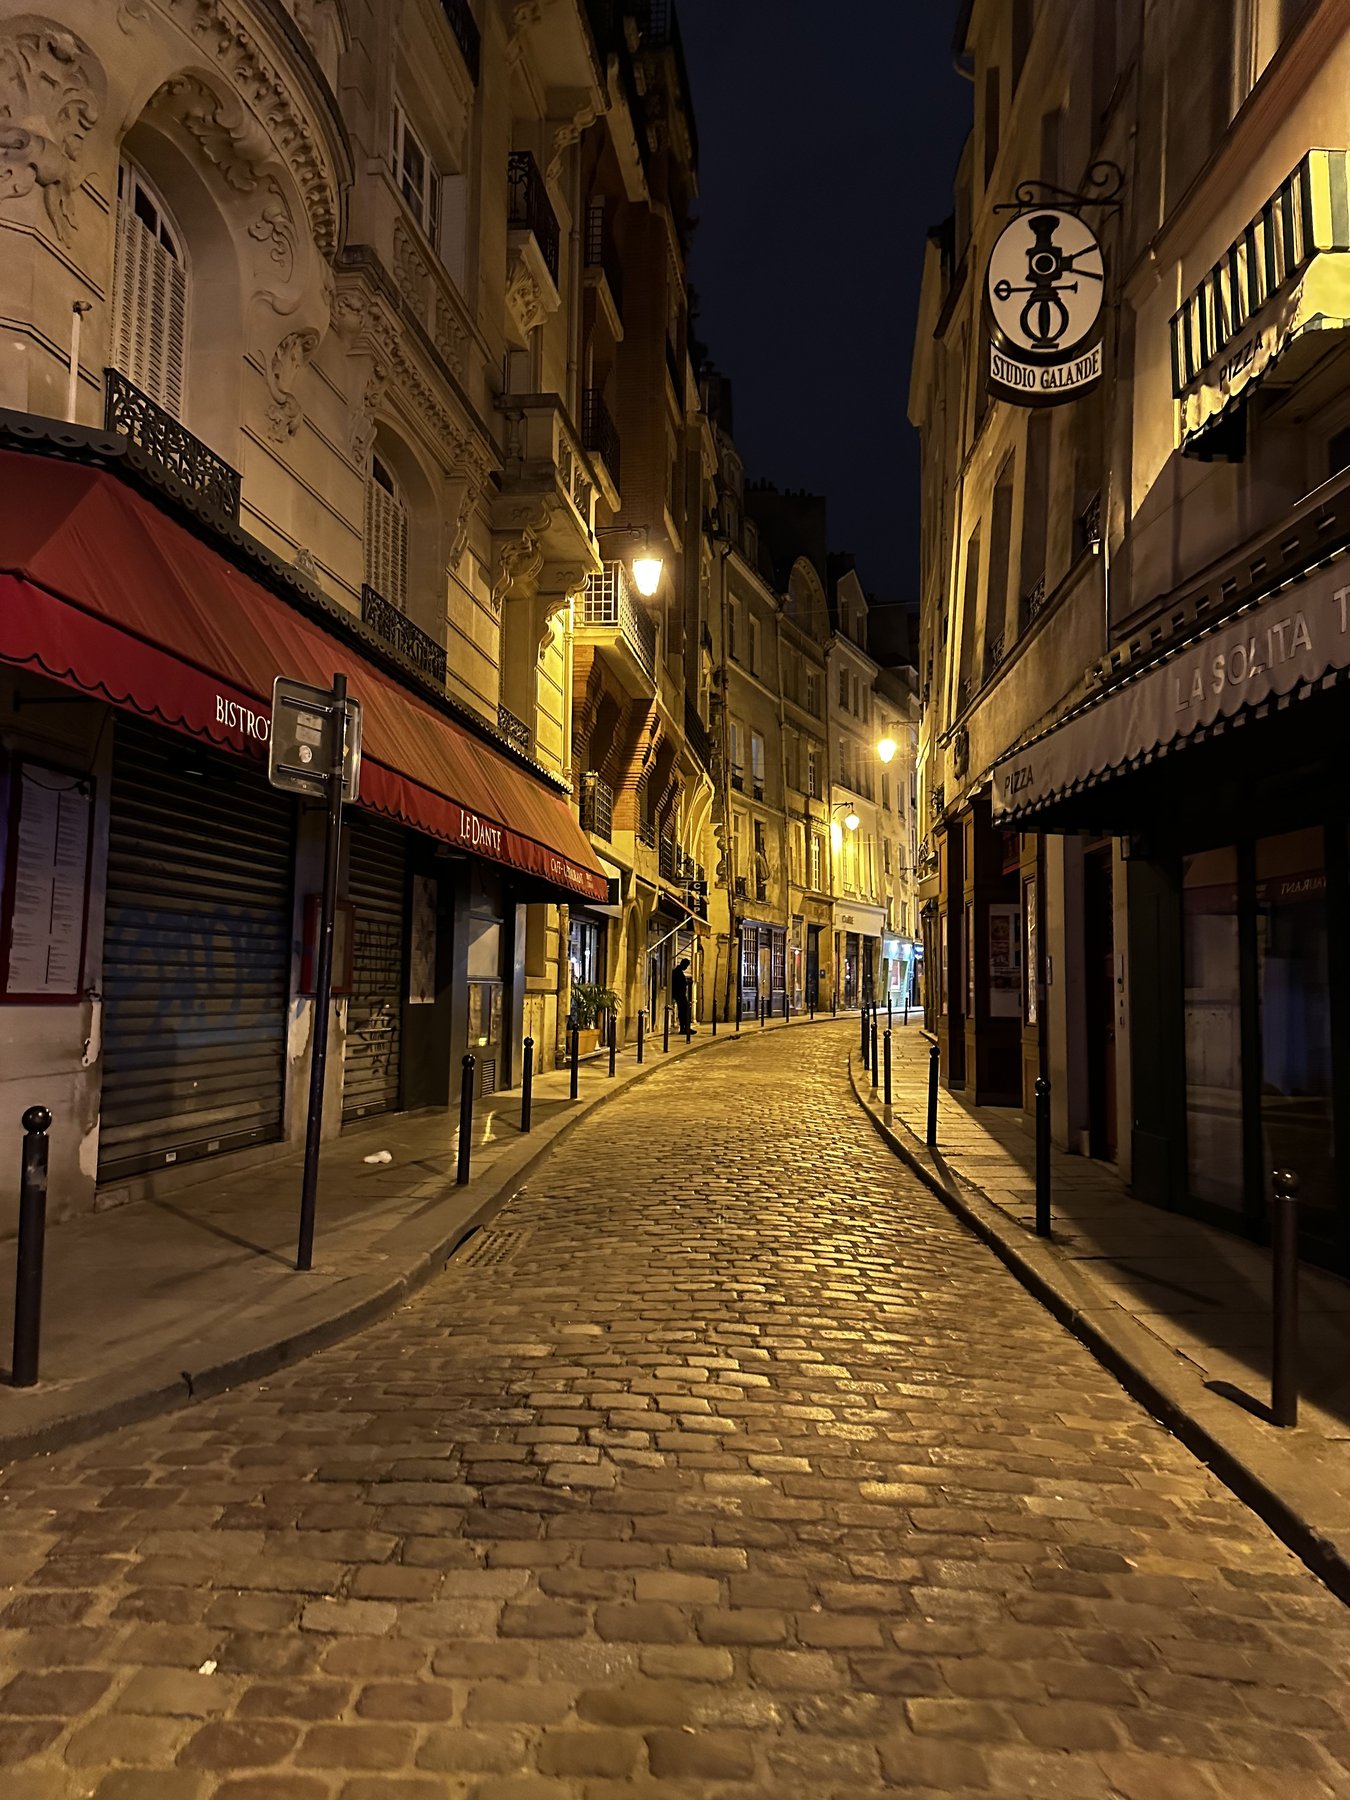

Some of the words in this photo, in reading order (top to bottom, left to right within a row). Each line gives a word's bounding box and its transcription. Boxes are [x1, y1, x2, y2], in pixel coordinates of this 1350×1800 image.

[992, 354, 1036, 388] STUDIO
[1040, 348, 1100, 389] GALANDE
[1219, 330, 1263, 391] PIZZA
[1175, 667, 1207, 713] LA
[1210, 611, 1313, 696] SOLITA
[215, 694, 271, 741] BISTRO
[1003, 763, 1034, 798] PIZZA
[460, 809, 471, 839] LE
[471, 814, 502, 851] DANTE
